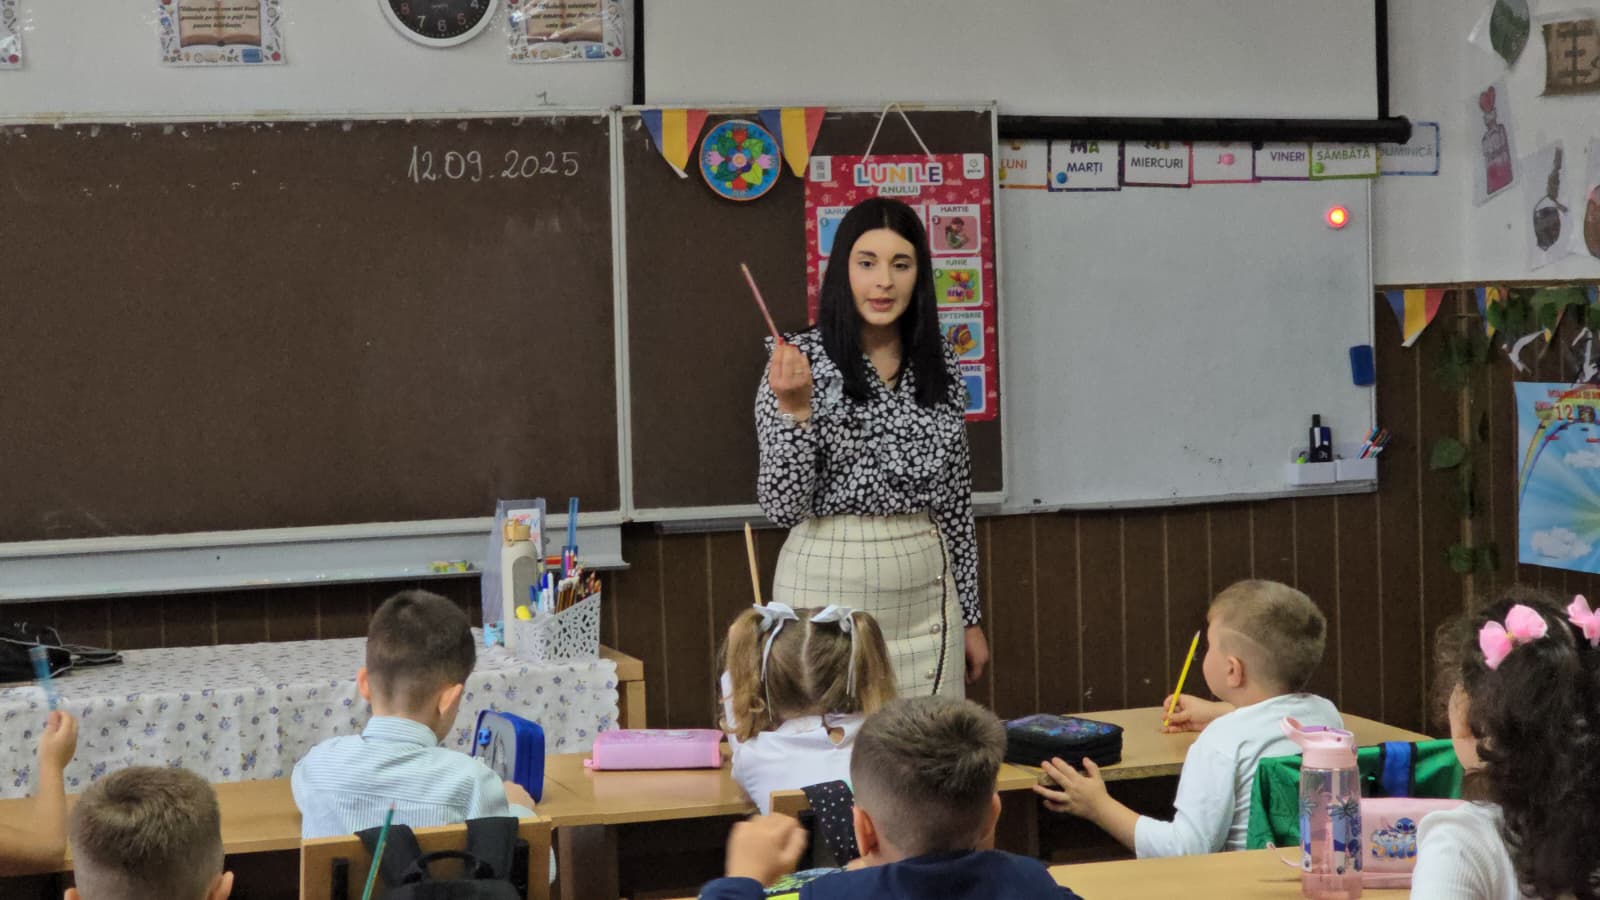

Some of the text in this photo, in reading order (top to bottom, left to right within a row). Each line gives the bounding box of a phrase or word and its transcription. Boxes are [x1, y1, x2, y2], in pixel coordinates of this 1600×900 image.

[417, 15, 426, 28] 7
[437, 20, 447, 32] 6
[1270, 151, 1306, 162] VINERI
[1000, 158, 1028, 169] LUNI
[1130, 156, 1184, 169] MIERCURI
[856, 165, 941, 184] LUNILE
[880, 186, 919, 194] ANULUI
[938, 312, 982, 320] EPTEMBRIE
